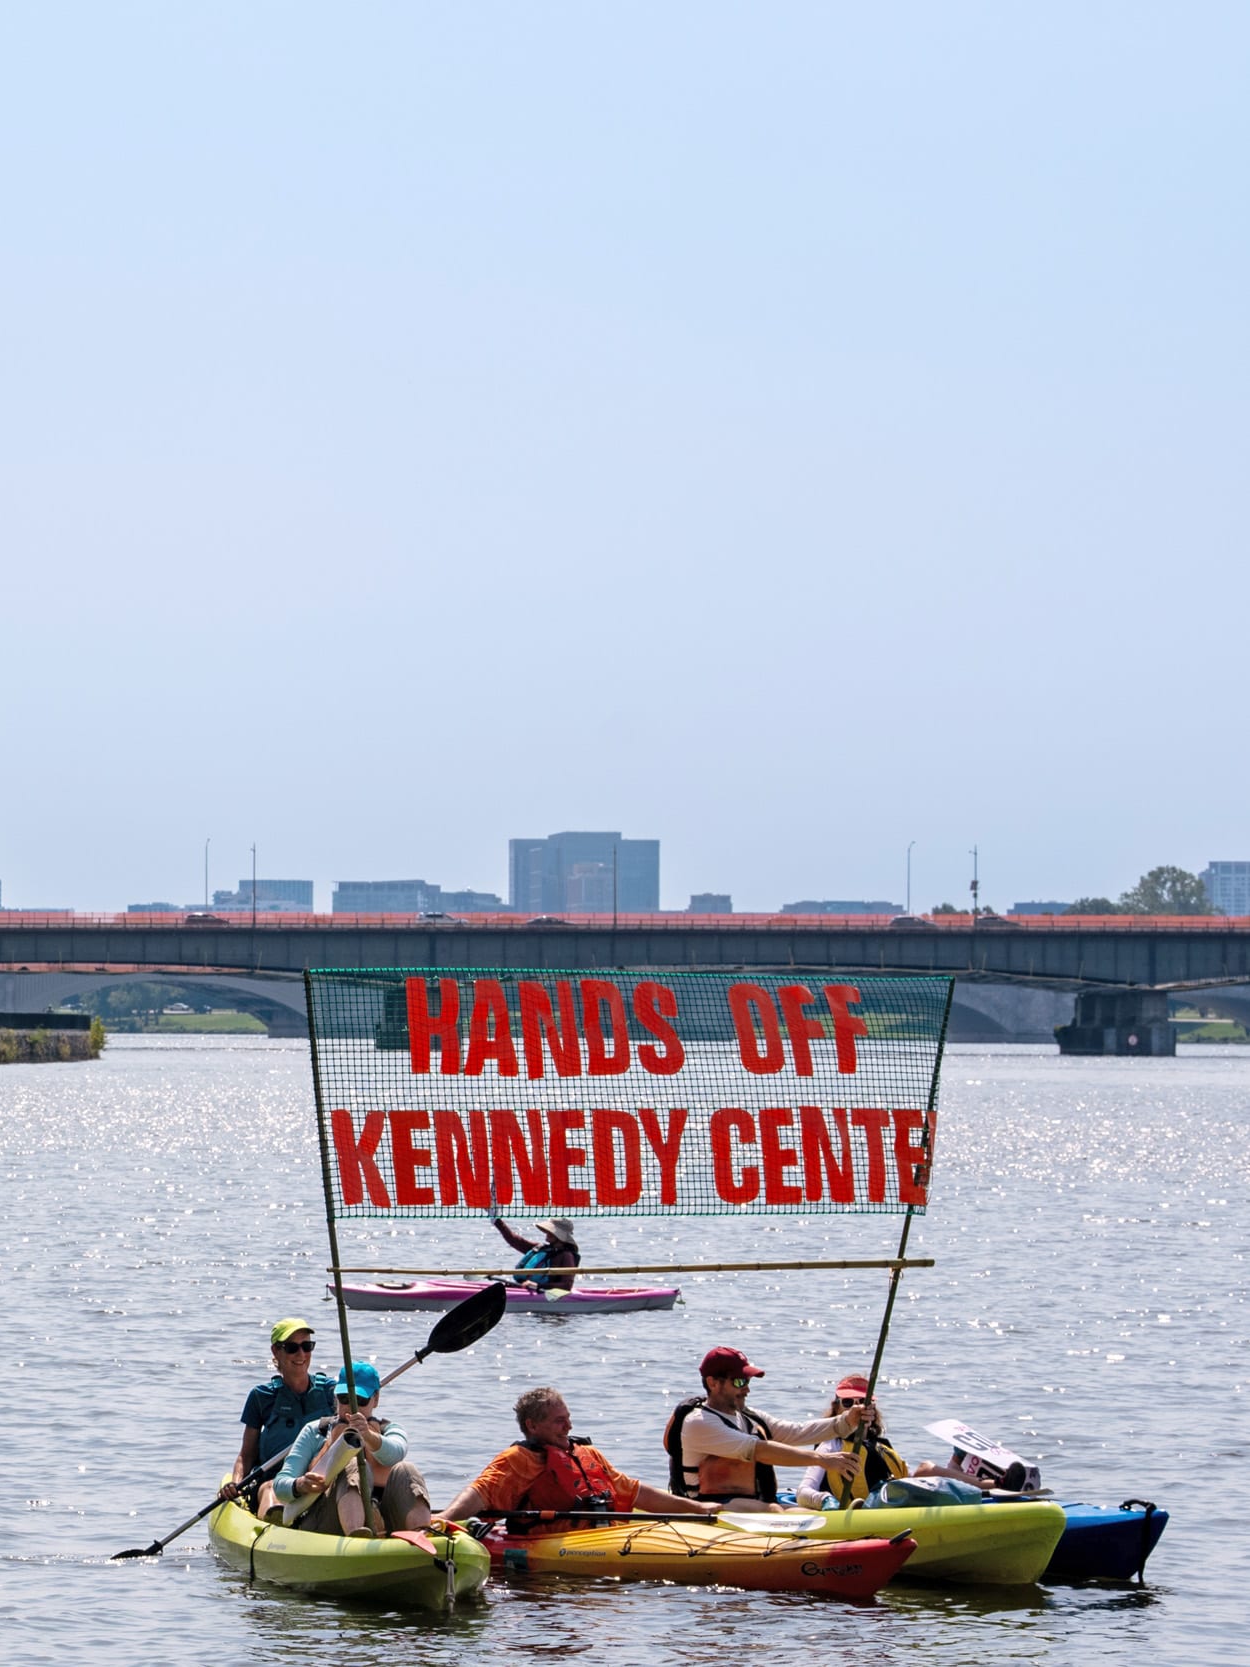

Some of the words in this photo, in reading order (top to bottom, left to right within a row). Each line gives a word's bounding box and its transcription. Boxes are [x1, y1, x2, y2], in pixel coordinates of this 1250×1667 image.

[405, 976, 685, 1080] HANDS
[728, 983, 868, 1077] OFF
[331, 1108, 688, 1209] KENNEDY
[710, 1106, 937, 1205] CENTE
